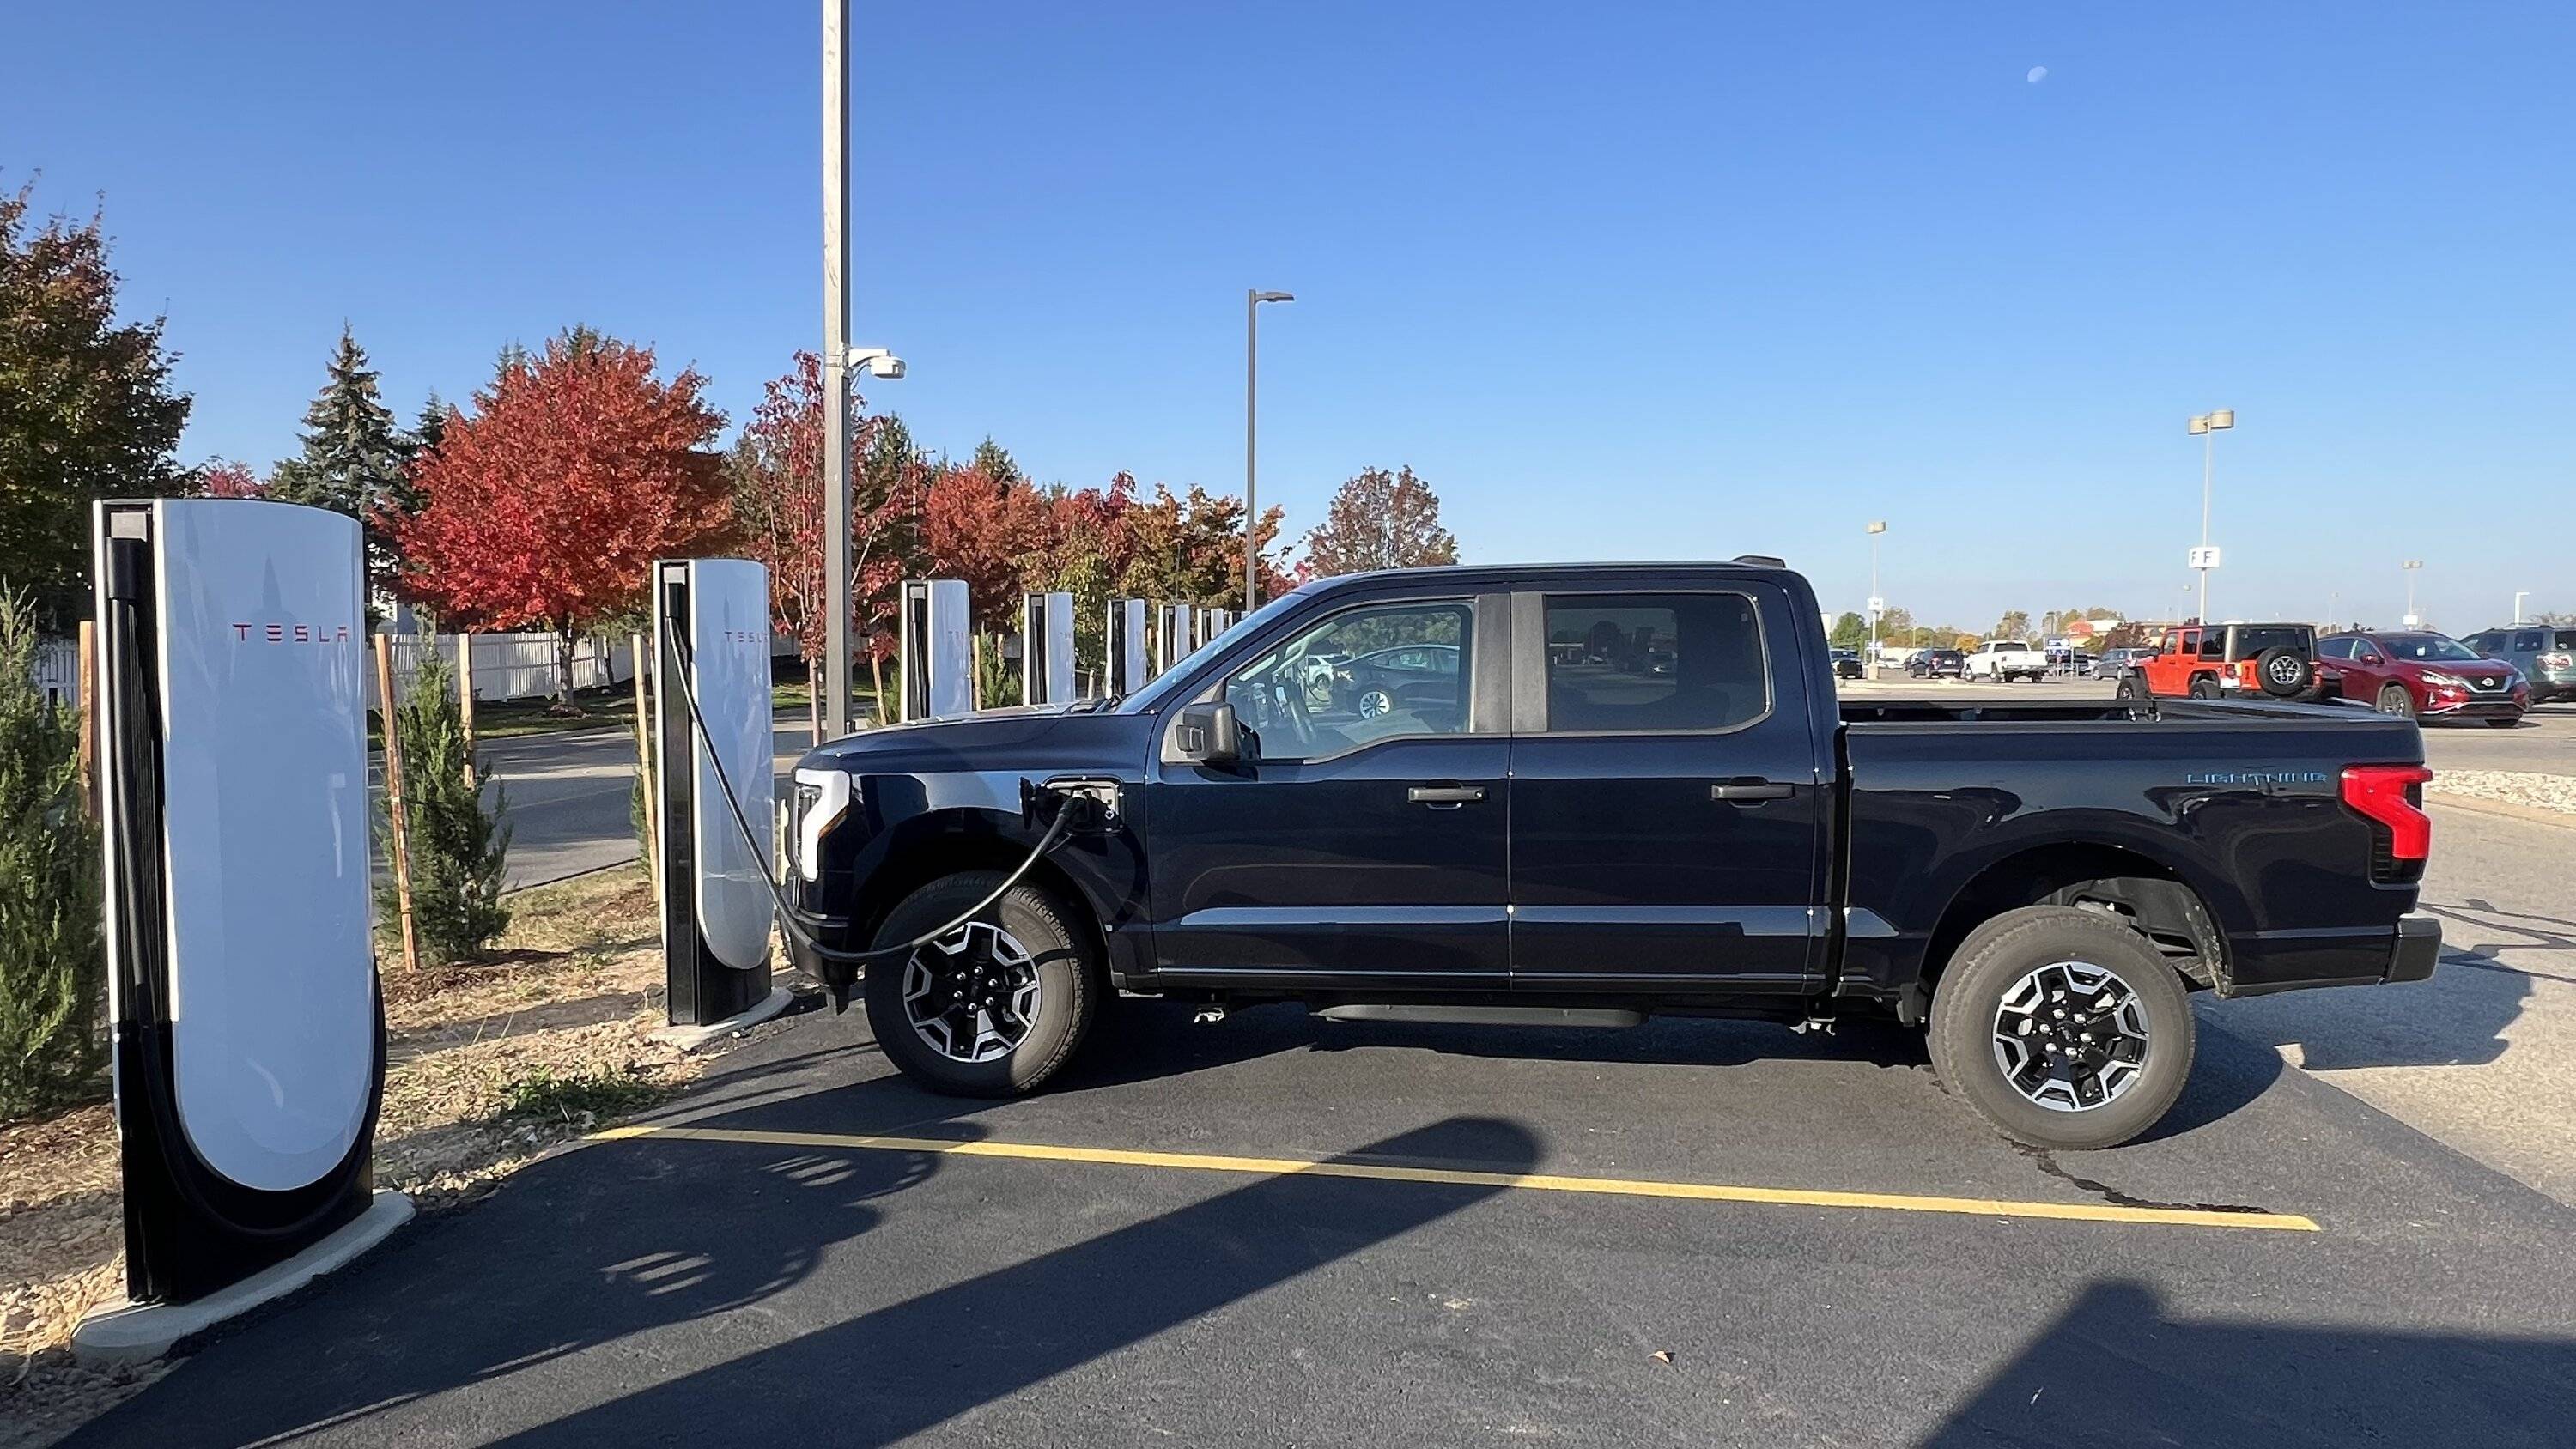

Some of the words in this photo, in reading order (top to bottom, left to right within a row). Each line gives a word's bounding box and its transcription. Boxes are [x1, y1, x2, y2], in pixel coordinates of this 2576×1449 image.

[2204, 550, 2213, 564] F
[232, 623, 348, 643] TESLA
[2186, 772, 2328, 786] LIGHTNING
